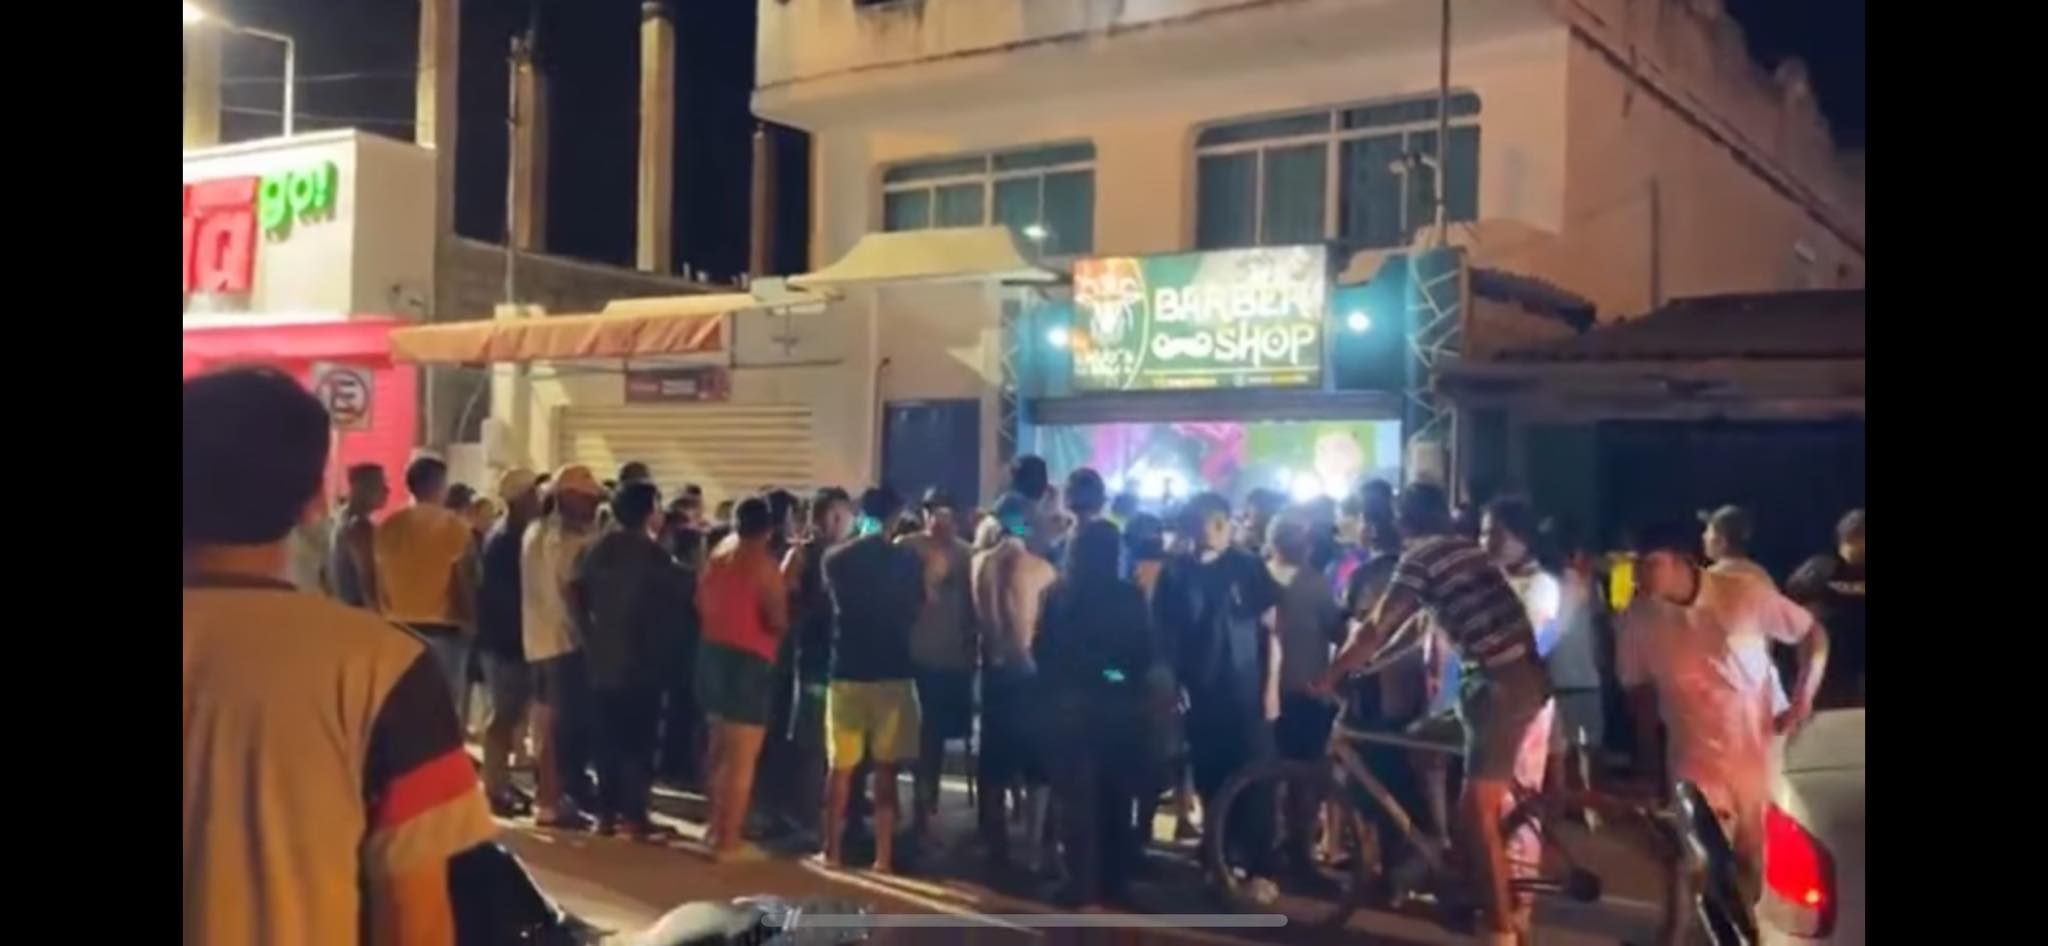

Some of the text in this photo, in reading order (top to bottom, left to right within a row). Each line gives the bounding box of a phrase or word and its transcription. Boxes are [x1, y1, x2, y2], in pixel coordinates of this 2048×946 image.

[259, 161, 337, 240] go!
[1154, 281, 1317, 322] BARBER
[1214, 321, 1315, 368] SHOP
